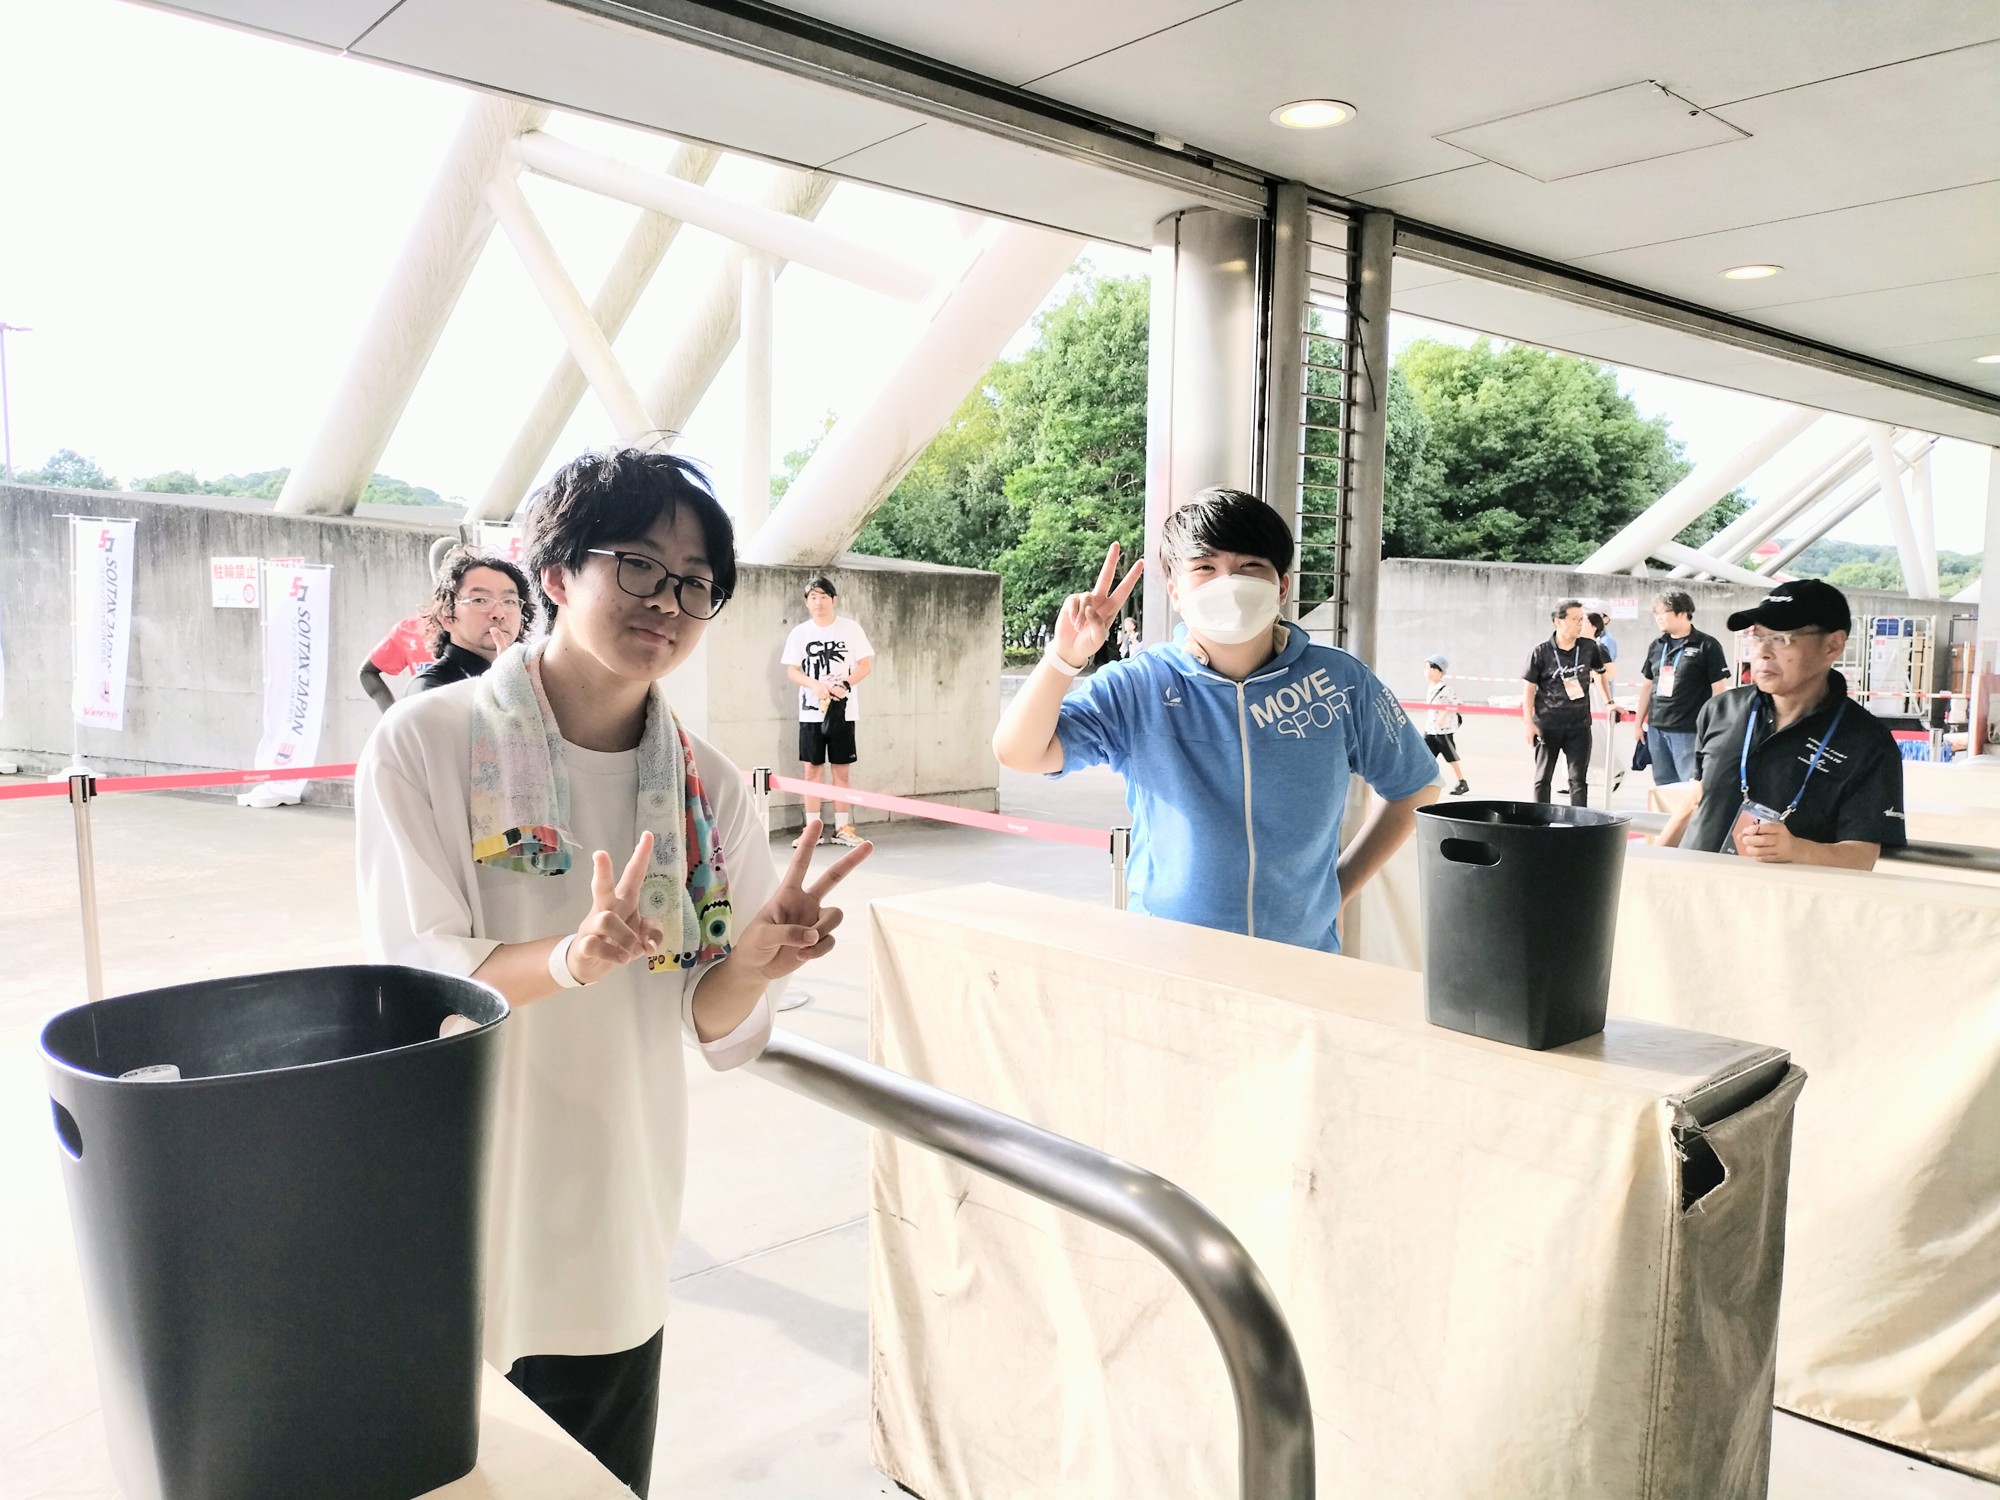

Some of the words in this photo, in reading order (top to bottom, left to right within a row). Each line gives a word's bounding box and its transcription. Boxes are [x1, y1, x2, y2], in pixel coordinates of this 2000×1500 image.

[106, 557, 118, 615] SOITAX
[213, 563, 257, 579] 駐輪禁止
[297, 606, 312, 671] SOITAX
[291, 674, 310, 736] JAPAN
[1249, 667, 1336, 729] MOVE
